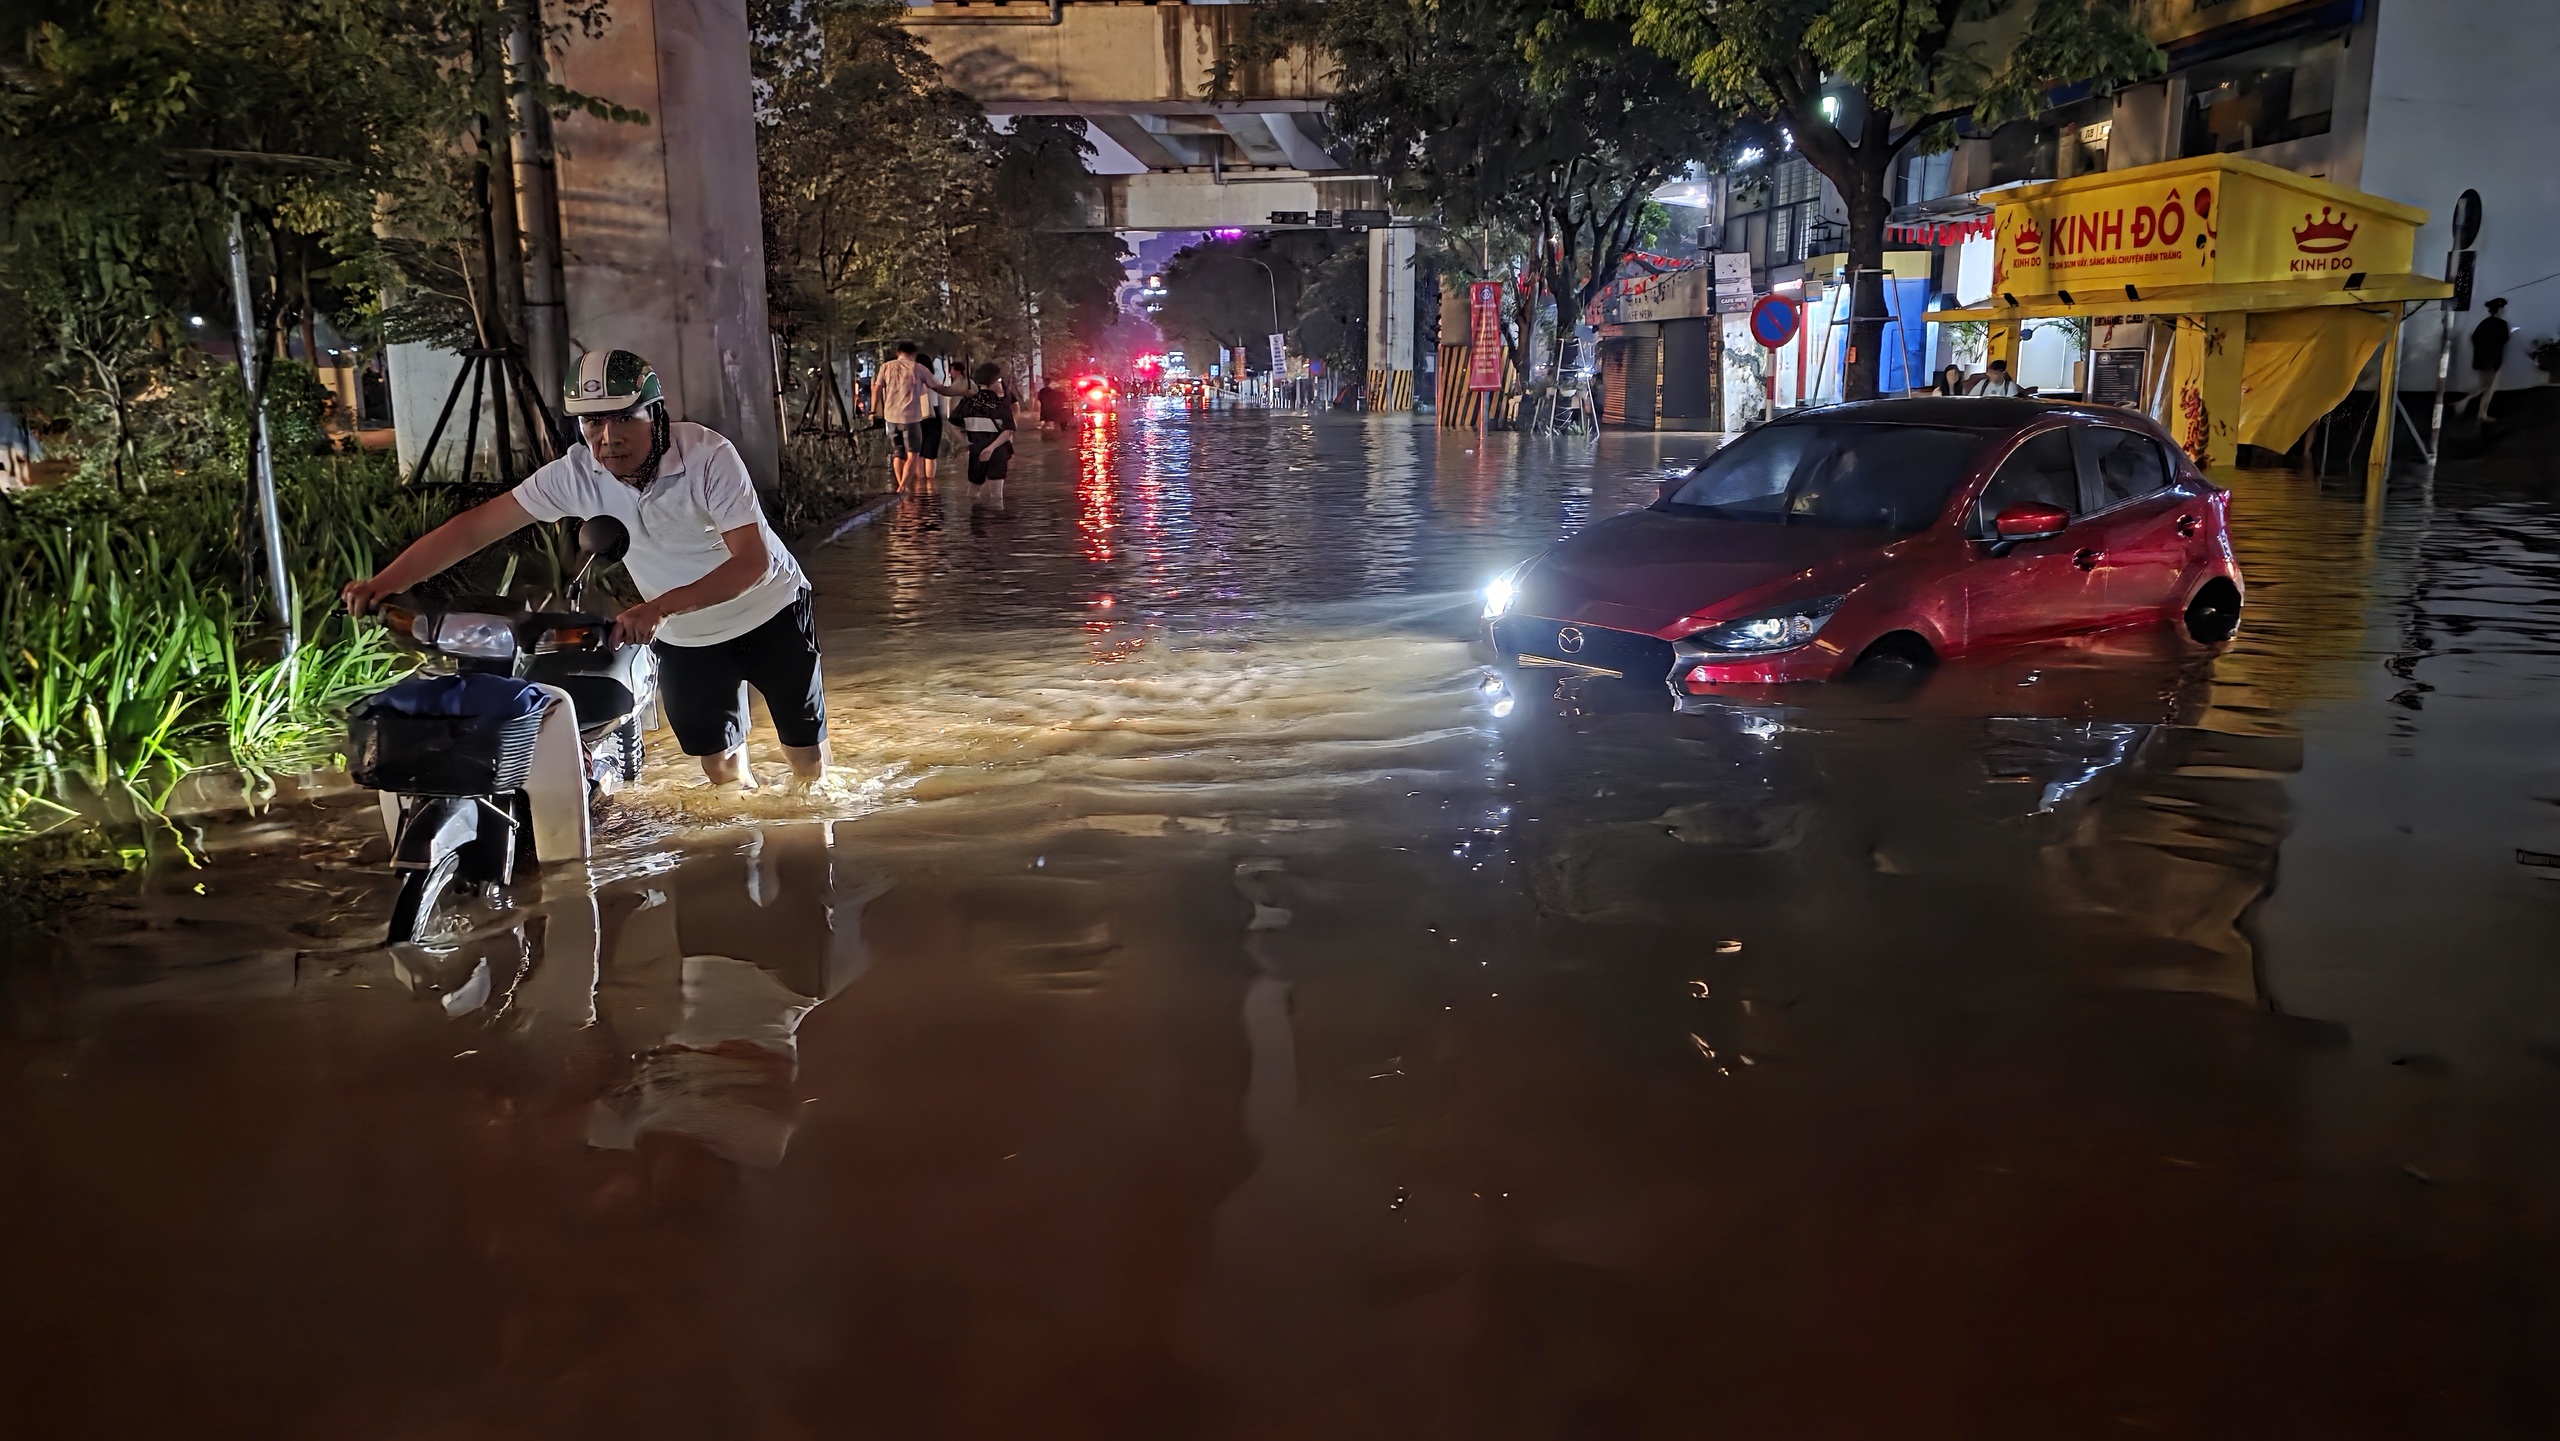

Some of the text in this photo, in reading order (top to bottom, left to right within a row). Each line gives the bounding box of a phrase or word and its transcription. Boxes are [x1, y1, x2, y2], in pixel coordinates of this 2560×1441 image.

[2049, 188, 2185, 257] KINH ĐÔ
[2013, 256, 2041, 268] KINH DO
[2290, 257, 2353, 272] KINH DO
